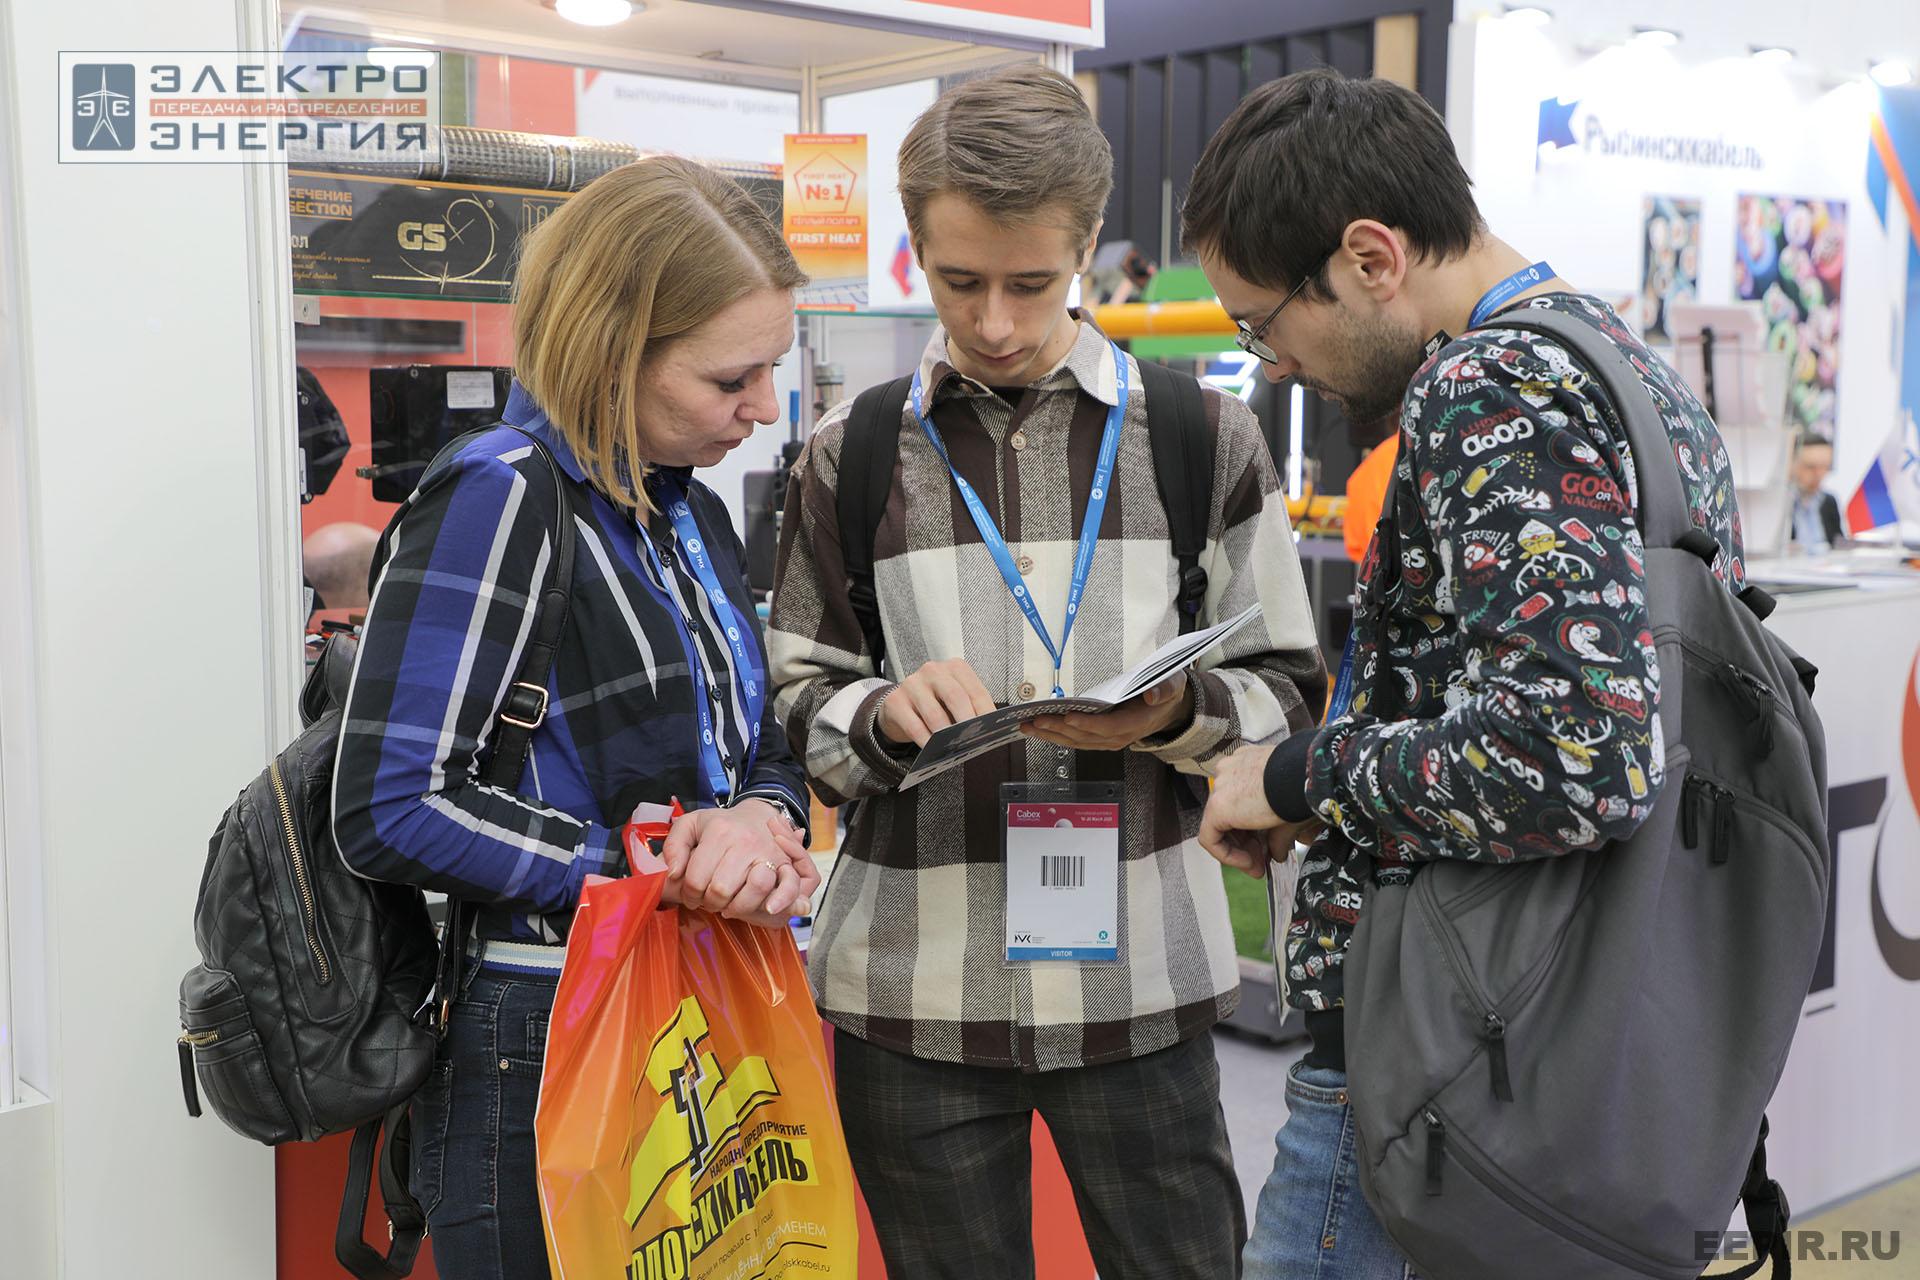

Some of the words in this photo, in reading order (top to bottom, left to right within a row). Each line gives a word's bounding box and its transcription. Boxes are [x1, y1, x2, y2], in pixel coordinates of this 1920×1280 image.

[397, 221, 447, 252] GS
[790, 233, 826, 244] FIRST
[829, 233, 862, 244] HEAT
[1016, 809, 1041, 819] Cabex
[1050, 950, 1073, 958] VISITOR
[743, 1120, 808, 1149] ПРЕДПРИЯТИЕ
